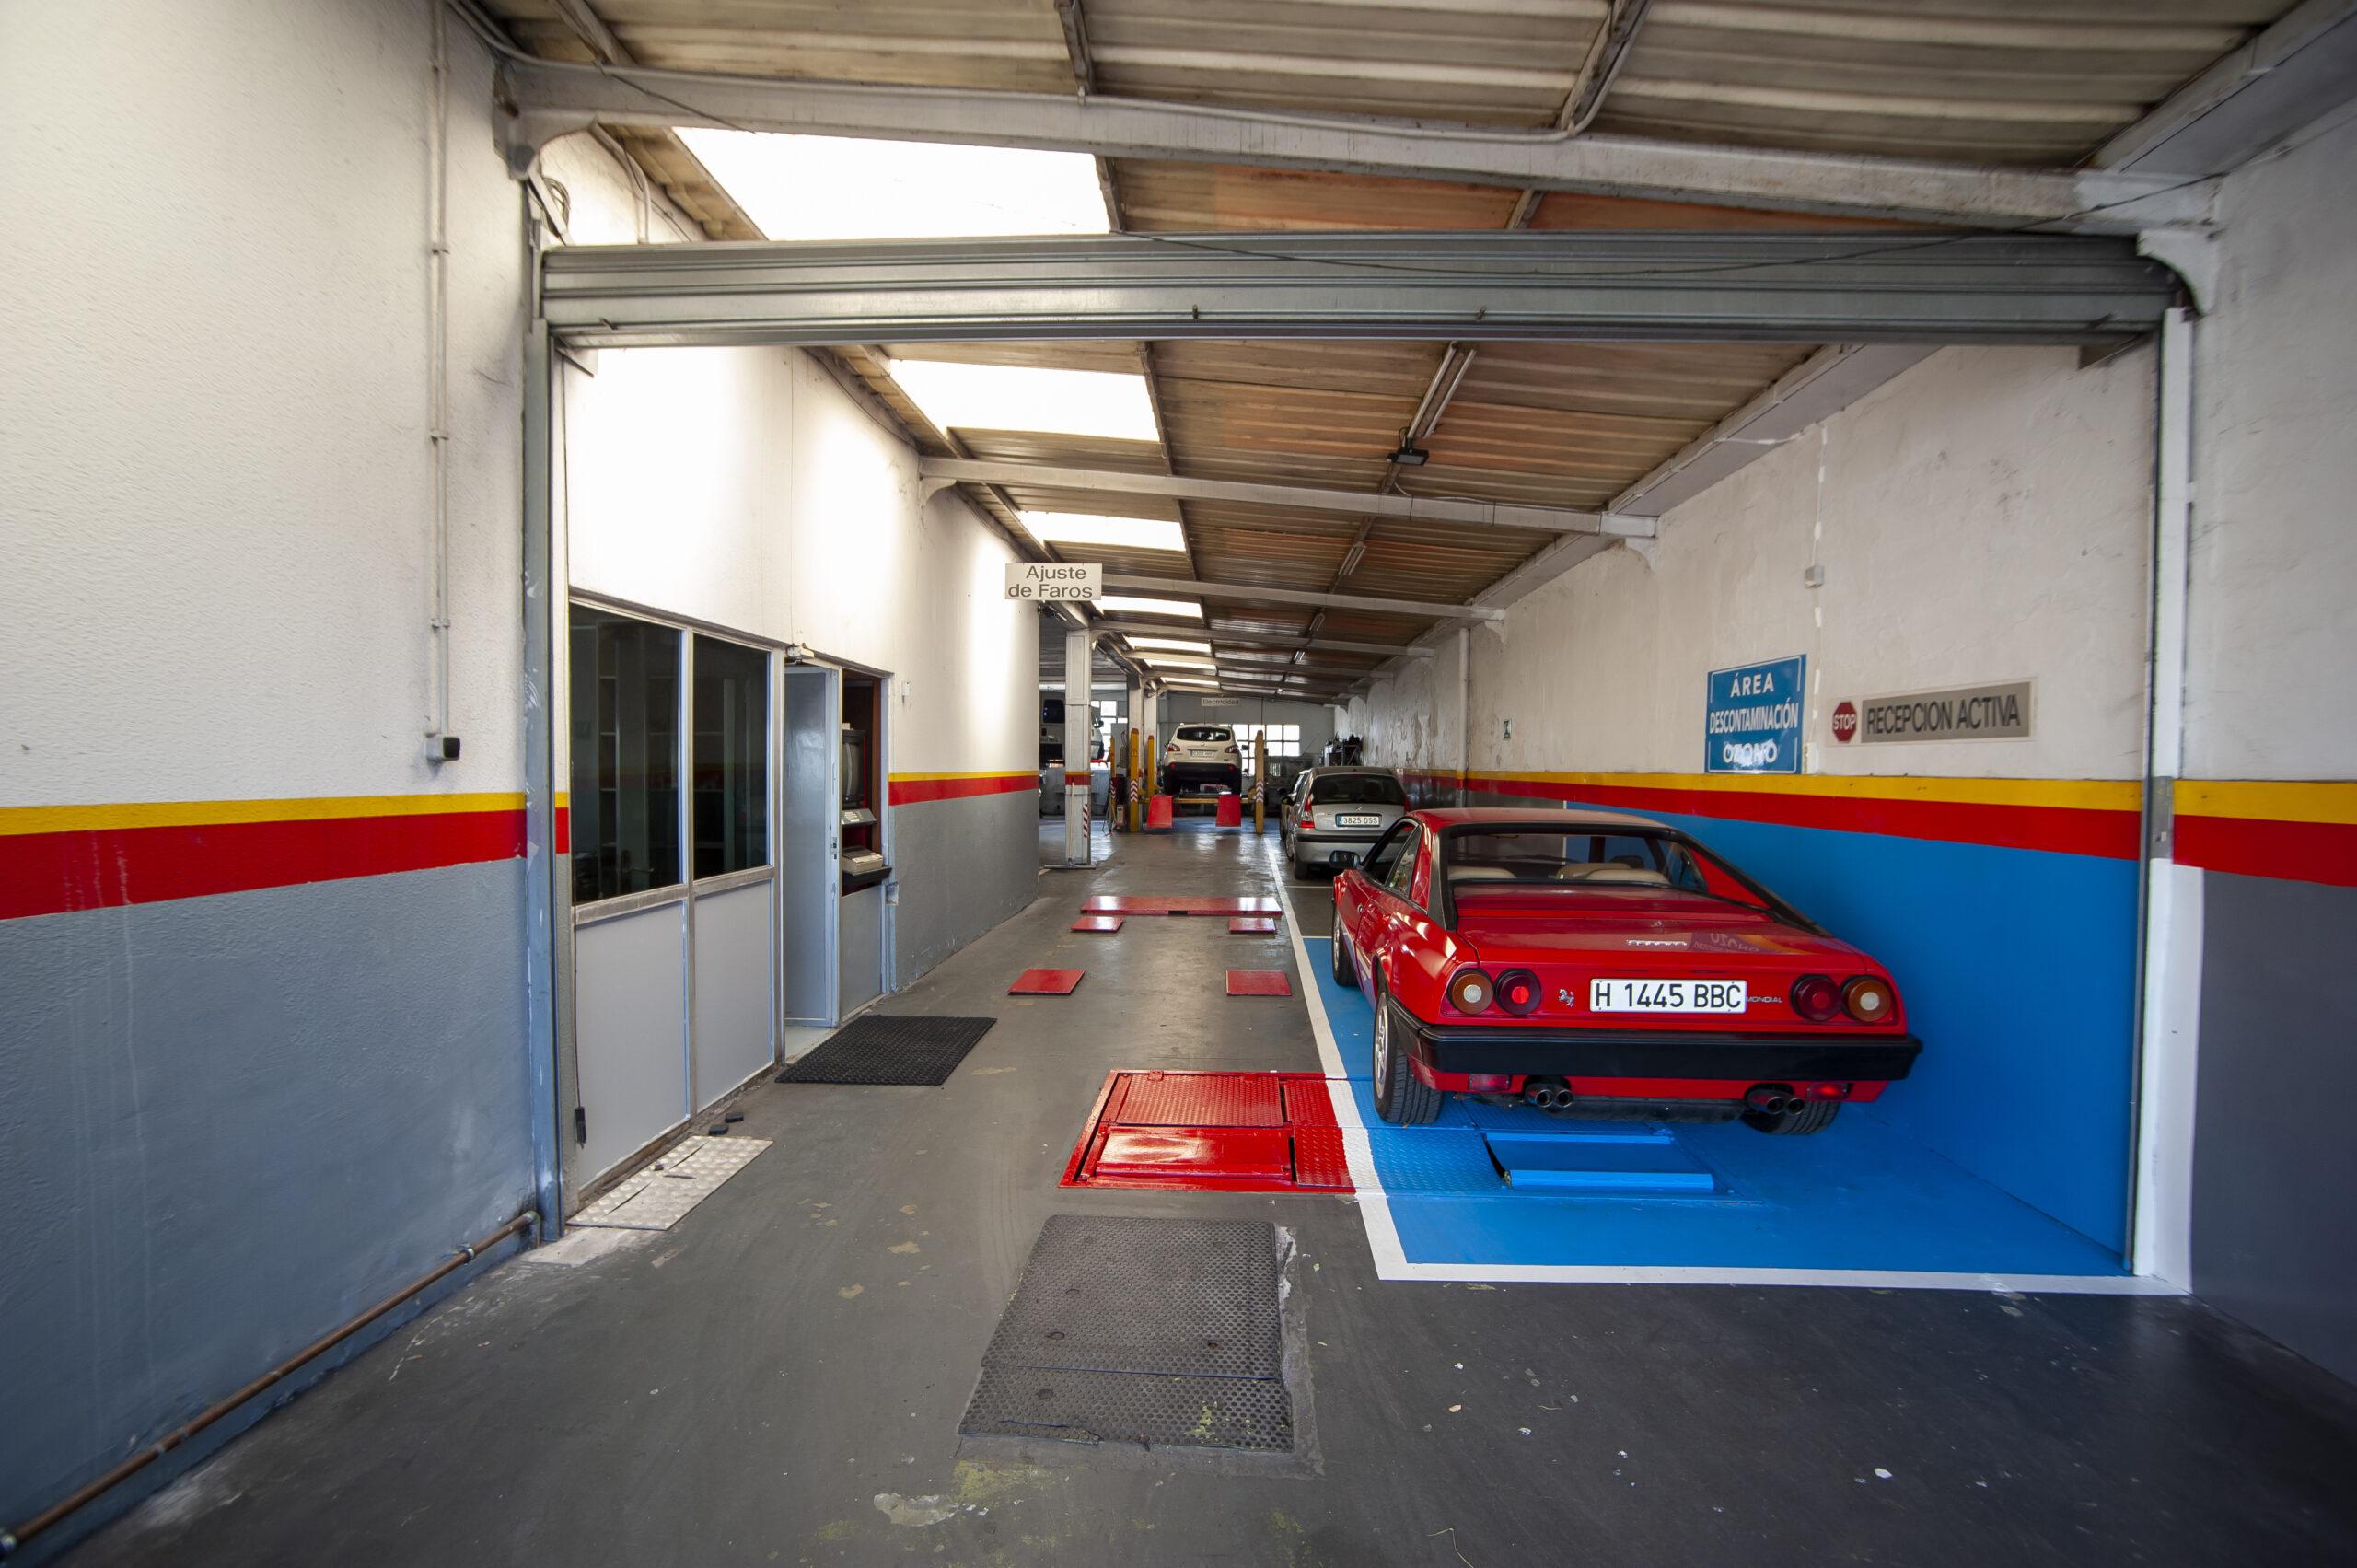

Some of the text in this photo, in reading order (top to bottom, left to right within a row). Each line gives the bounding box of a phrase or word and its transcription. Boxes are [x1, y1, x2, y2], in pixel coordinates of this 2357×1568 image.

[1026, 565, 1086, 582] Ajuste
[1008, 584, 1093, 598] de Faros
[1730, 672, 1774, 698] ÁREA
[1709, 697, 1799, 735] DESCONTAMINACIÓN
[1833, 714, 1857, 730] STOP
[1866, 693, 2021, 735] RECEPCION ACTIVA
[1723, 741, 1777, 764] OZONO
[1596, 982, 1741, 1008] H 1445 BBC
